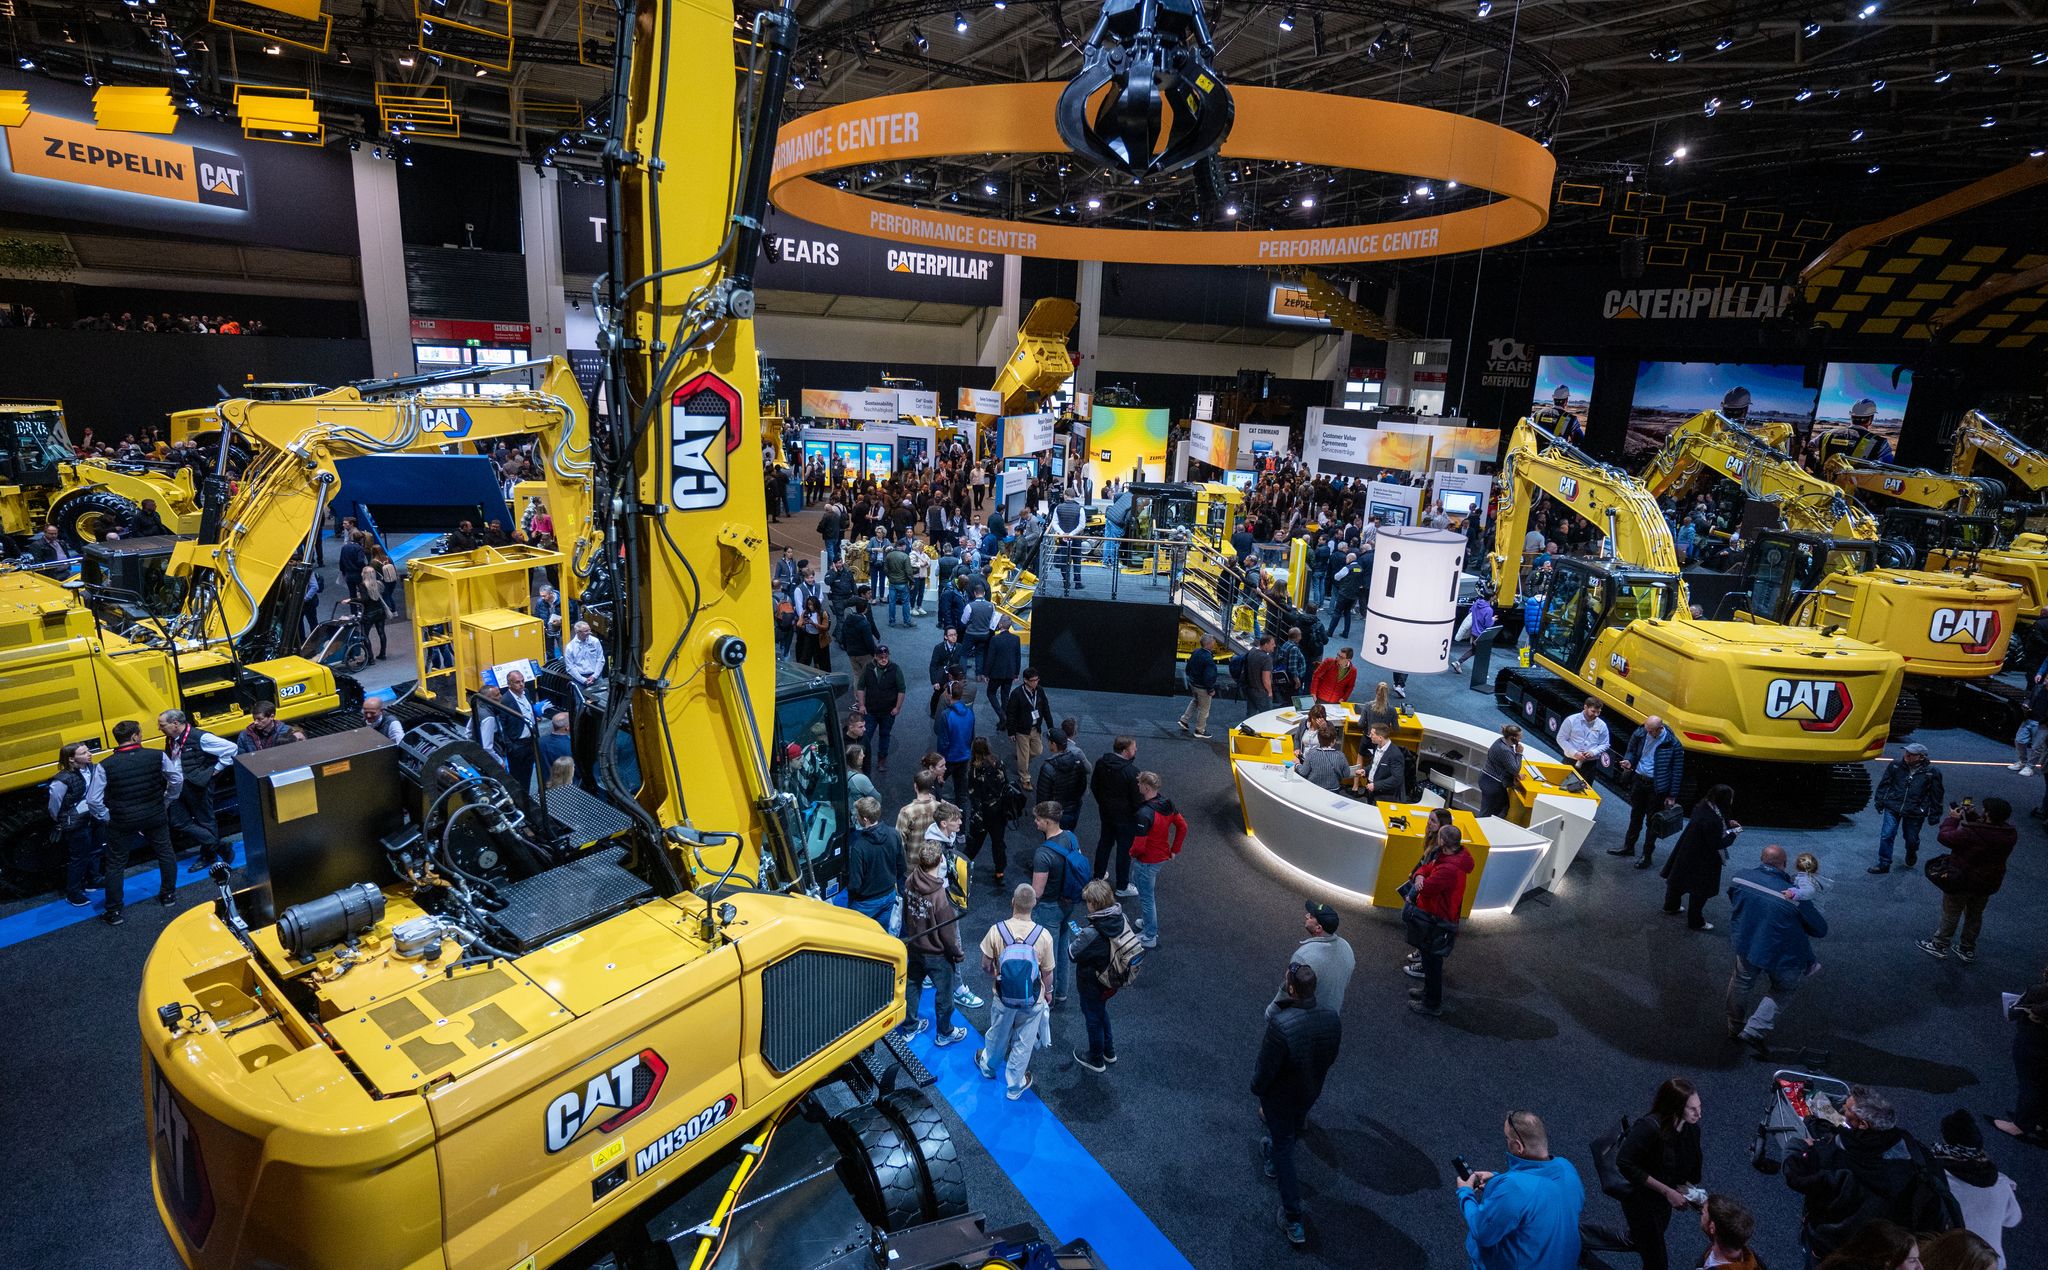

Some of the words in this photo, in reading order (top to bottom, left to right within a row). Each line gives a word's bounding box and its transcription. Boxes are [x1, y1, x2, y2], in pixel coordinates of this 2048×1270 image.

[838, 112, 919, 151] CENTER
[44, 136, 184, 180] ZEPPELIN
[200, 163, 241, 196] CAT
[870, 211, 975, 244] PERFORMANCE
[979, 229, 1037, 250] CENTER
[1258, 235, 1379, 258] PERFORMANCE
[1382, 228, 1439, 250] CENTER
[422, 408, 460, 433] CAT
[1322, 432, 1343, 440] Customer
[1322, 440, 1347, 448] Agreements
[673, 406, 727, 510] CAT
[1321, 446, 1355, 456] Serviceverträge
[2004, 451, 2018, 465] CAT
[1726, 456, 1744, 475] CAT
[1560, 476, 1577, 496] CAT
[1884, 478, 1903, 494] CAT
[1930, 609, 1992, 644] CAT
[1376, 634, 1389, 655] 3
[1440, 639, 1448, 660] 3
[1611, 652, 1627, 671] CAT
[280, 684, 300, 698] 320
[1766, 679, 1837, 719] CAT
[547, 1054, 641, 1151] CAT
[637, 1100, 727, 1176] MH3022
